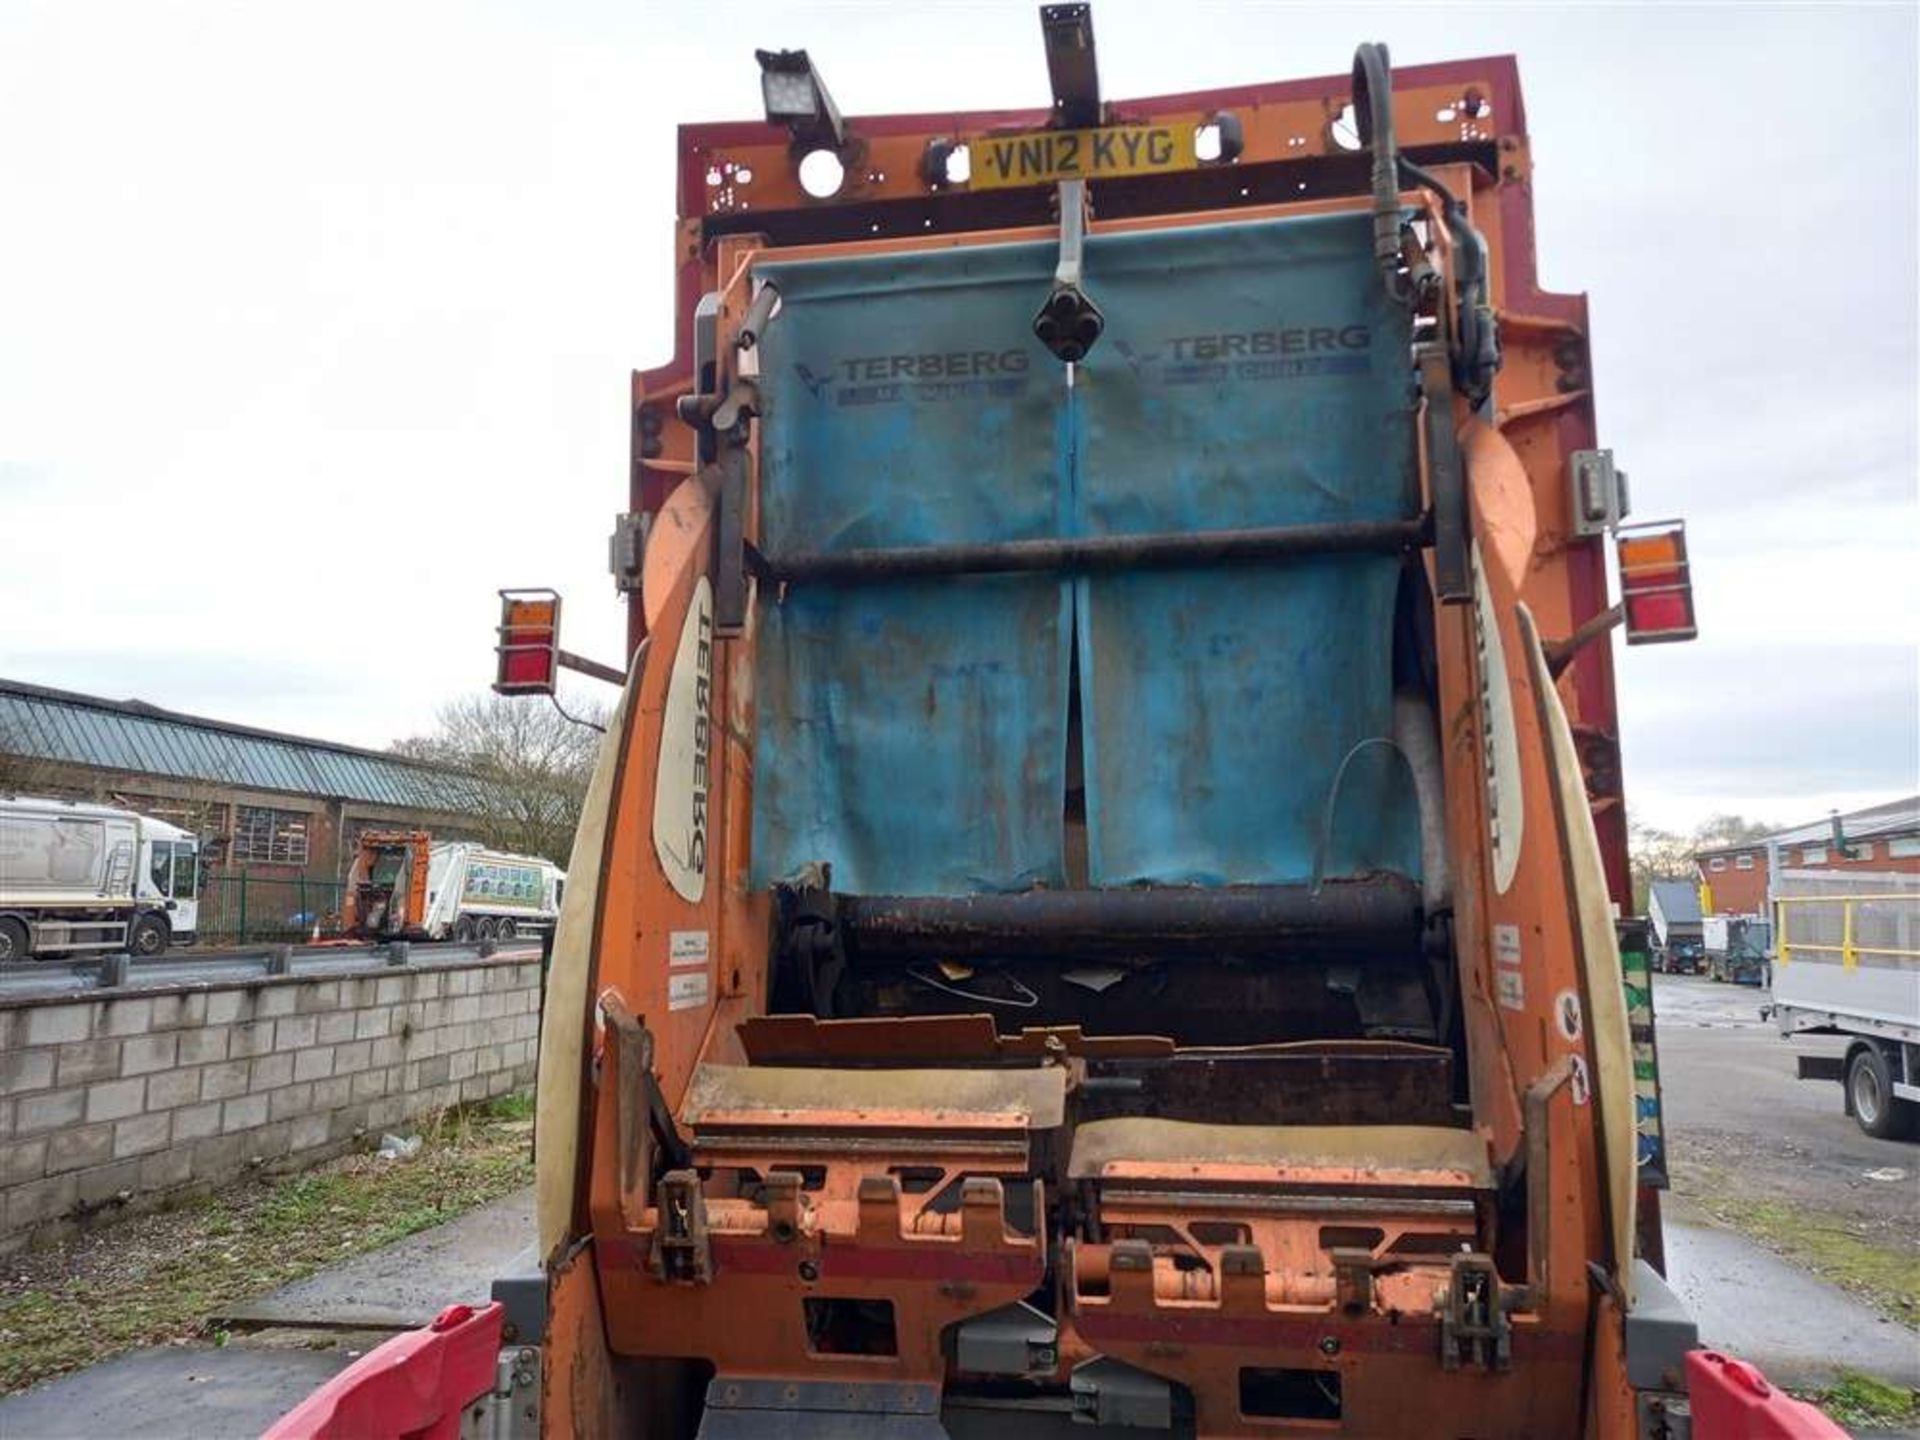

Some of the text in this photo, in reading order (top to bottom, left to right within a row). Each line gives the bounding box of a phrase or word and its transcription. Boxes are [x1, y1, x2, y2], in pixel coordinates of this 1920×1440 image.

[993, 130, 1173, 180] VN12 KYG
[1168, 324, 1371, 360] TERBERG
[839, 350, 1030, 381] TERBERG
